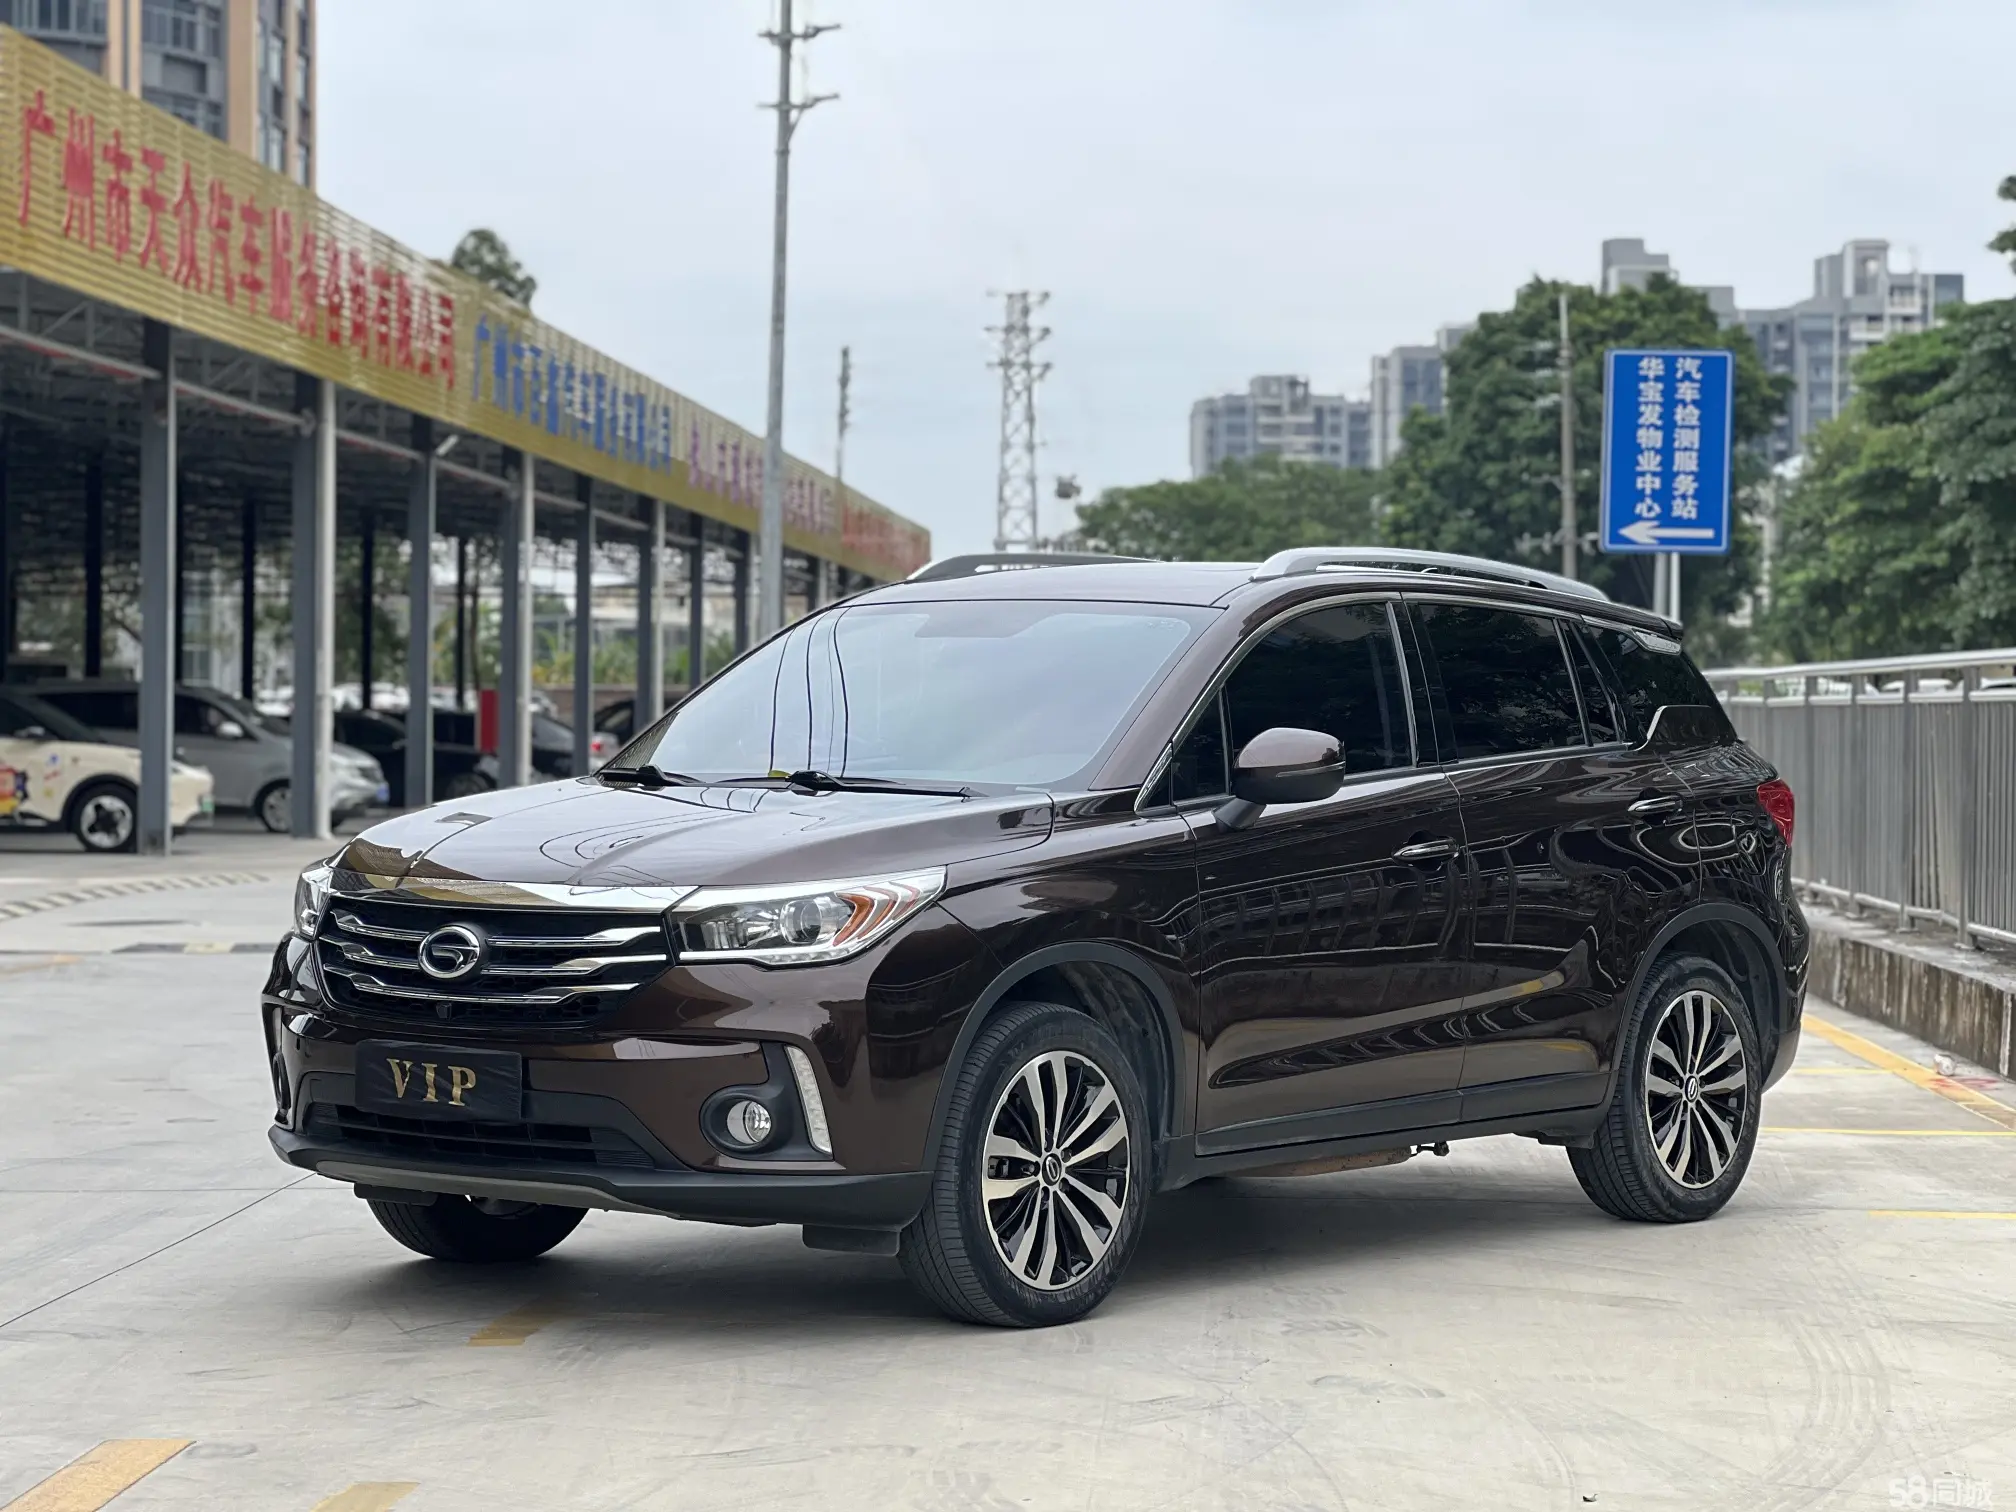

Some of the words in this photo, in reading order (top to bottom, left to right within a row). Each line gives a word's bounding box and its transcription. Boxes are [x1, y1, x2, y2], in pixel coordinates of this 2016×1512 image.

[1634, 356, 1665, 519] 华宝发物业中心
[1670, 356, 1703, 520] 汽车检测服务站
[386, 1058, 477, 1107] VIP
